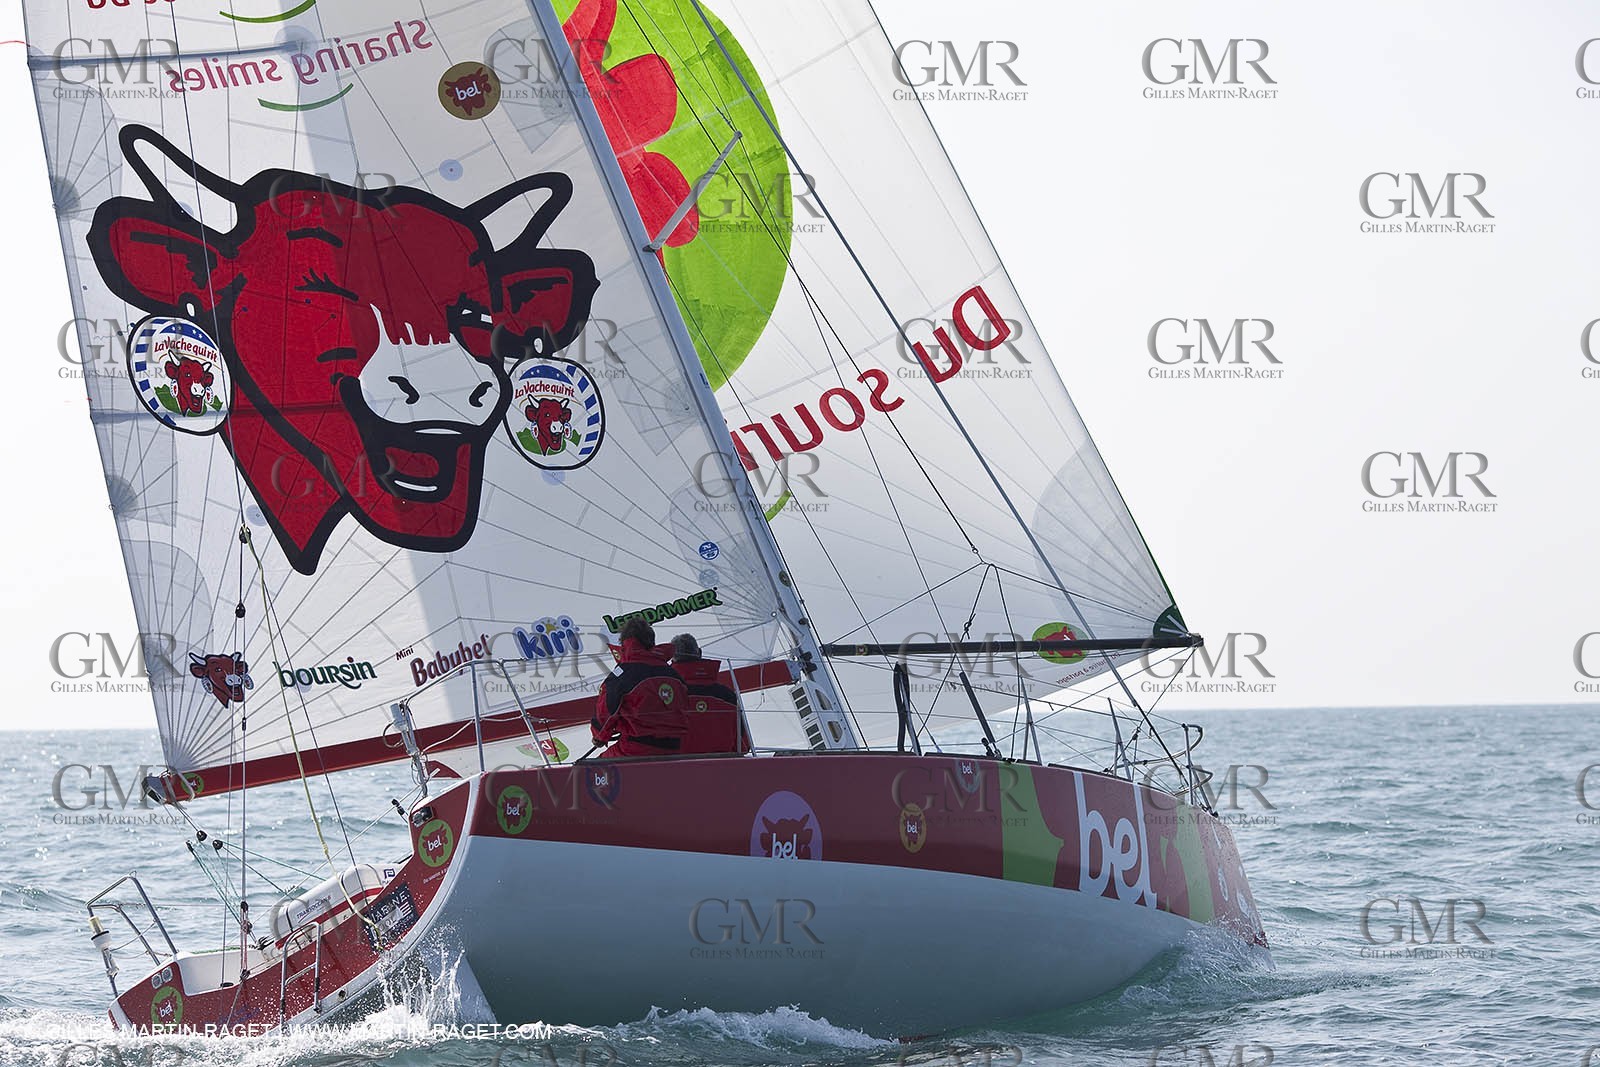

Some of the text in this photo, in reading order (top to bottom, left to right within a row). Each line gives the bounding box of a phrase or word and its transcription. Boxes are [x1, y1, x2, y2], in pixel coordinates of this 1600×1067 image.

[455, 84, 481, 102] bel
[164, 336, 192, 352] Vache
[192, 345, 208, 357] qui
[523, 381, 551, 395] Vache
[551, 384, 566, 396] qui
[515, 616, 582, 659] kiri
[395, 645, 414, 661] Mini
[410, 634, 491, 688] Babybel
[962, 761, 973, 775] bel
[594, 772, 609, 786] bel
[505, 802, 520, 817] bel
[906, 820, 919, 834] bel
[427, 835, 442, 852] bel
[771, 832, 799, 860] bel
[1073, 770, 1157, 910] bel
